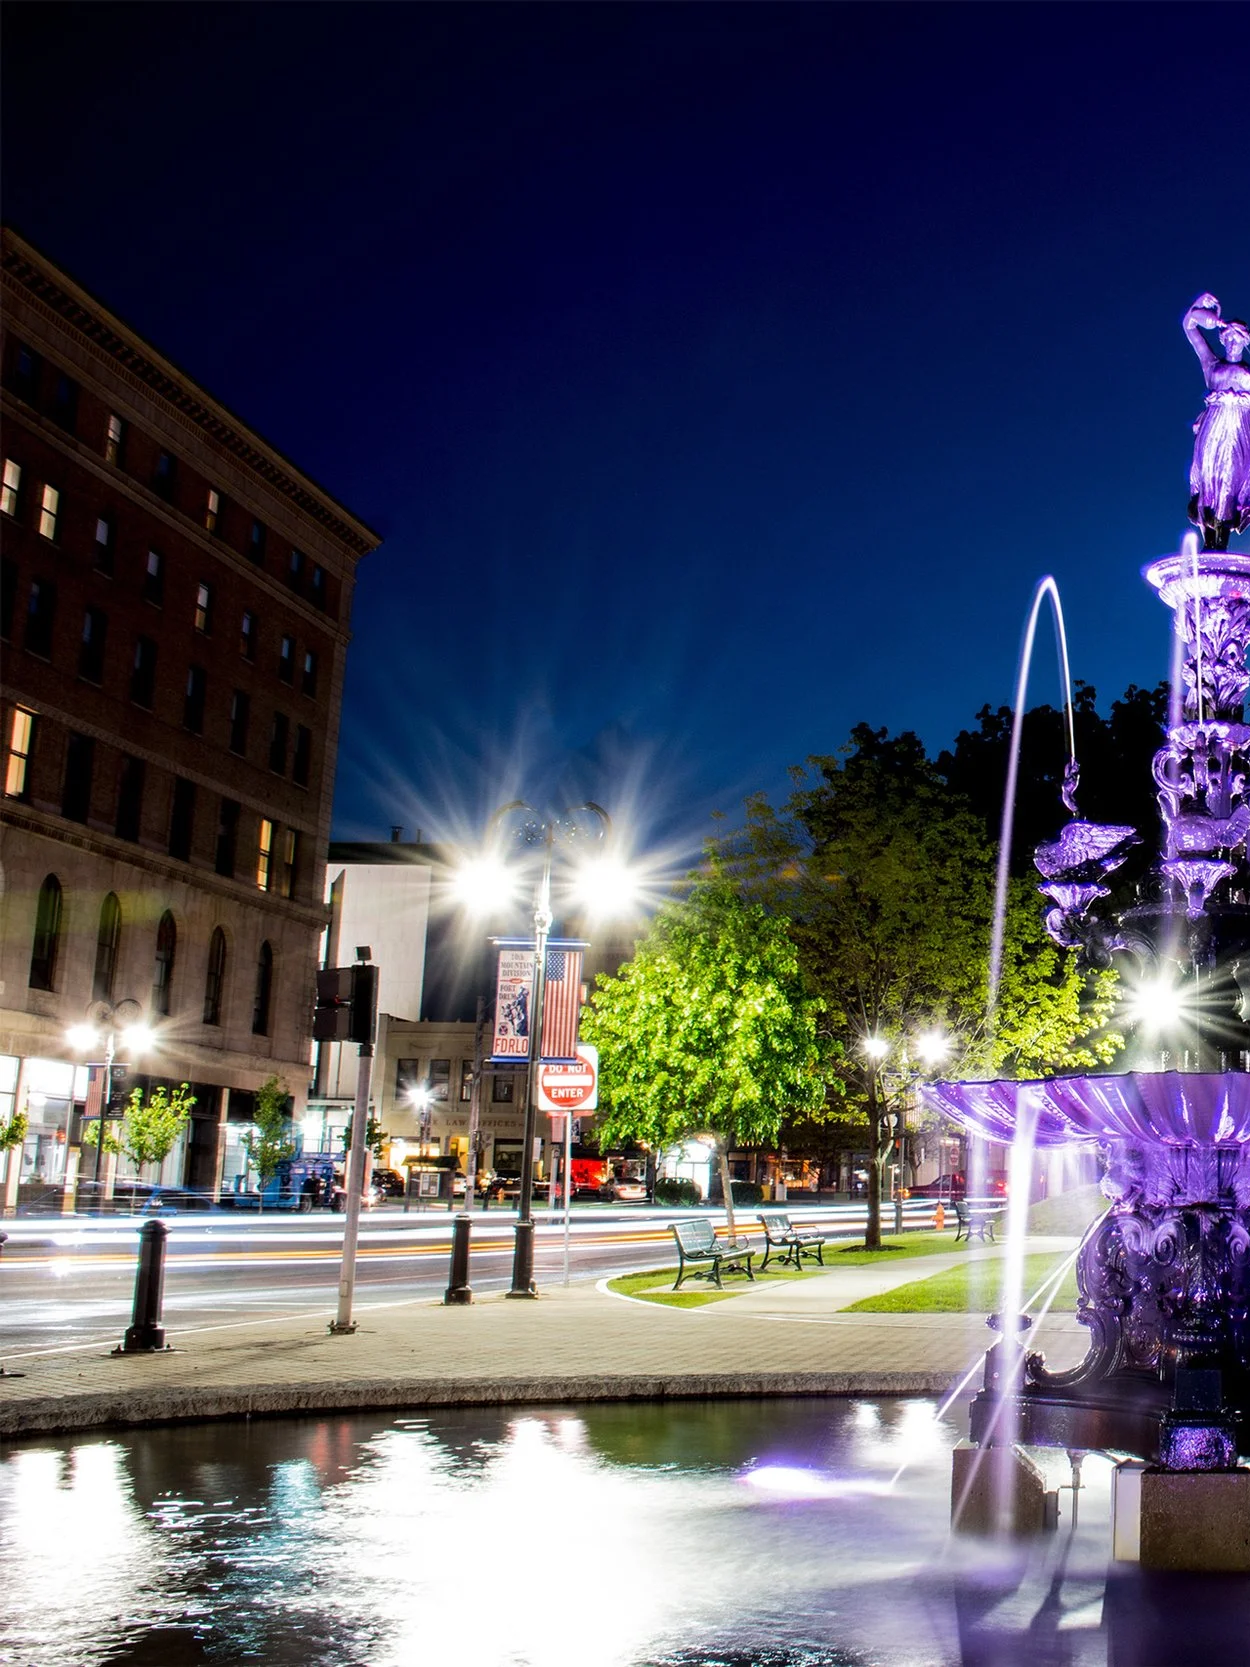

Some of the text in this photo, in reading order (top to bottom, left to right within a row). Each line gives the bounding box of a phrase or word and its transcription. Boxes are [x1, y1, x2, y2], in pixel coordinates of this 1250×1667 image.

[502, 969, 531, 977] DIVISION
[500, 984, 516, 992] FORT
[494, 1038, 529, 1054] FDRLO
[549, 1064, 587, 1073] DO NOT
[551, 1088, 584, 1099] ENTER
[445, 1118, 468, 1127] LAW
